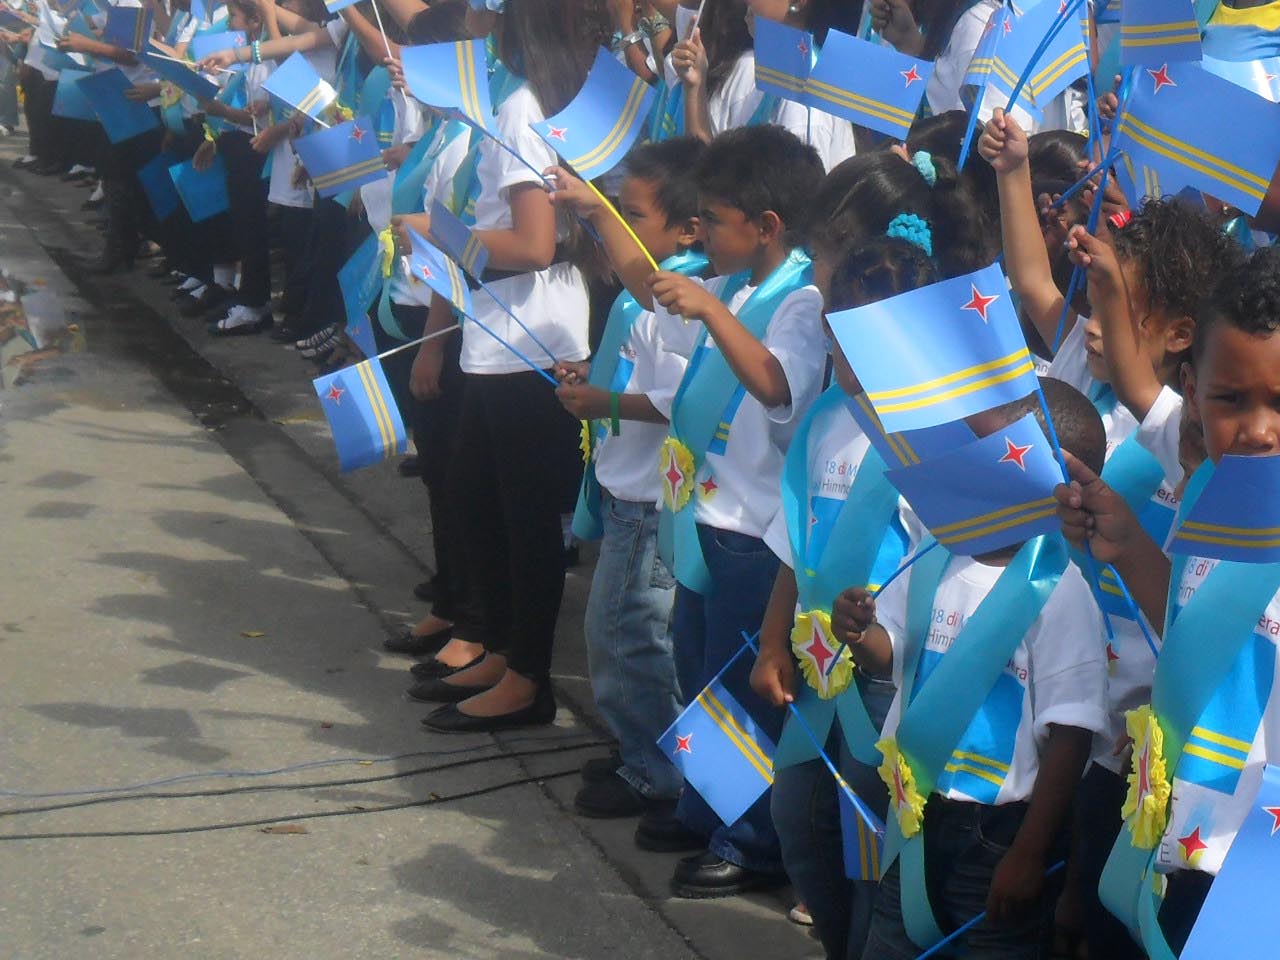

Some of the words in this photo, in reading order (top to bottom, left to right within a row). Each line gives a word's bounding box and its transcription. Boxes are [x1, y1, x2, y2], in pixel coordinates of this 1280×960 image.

[825, 460, 836, 474] 18
[1195, 561, 1209, 577] di
[946, 610, 960, 628] di
